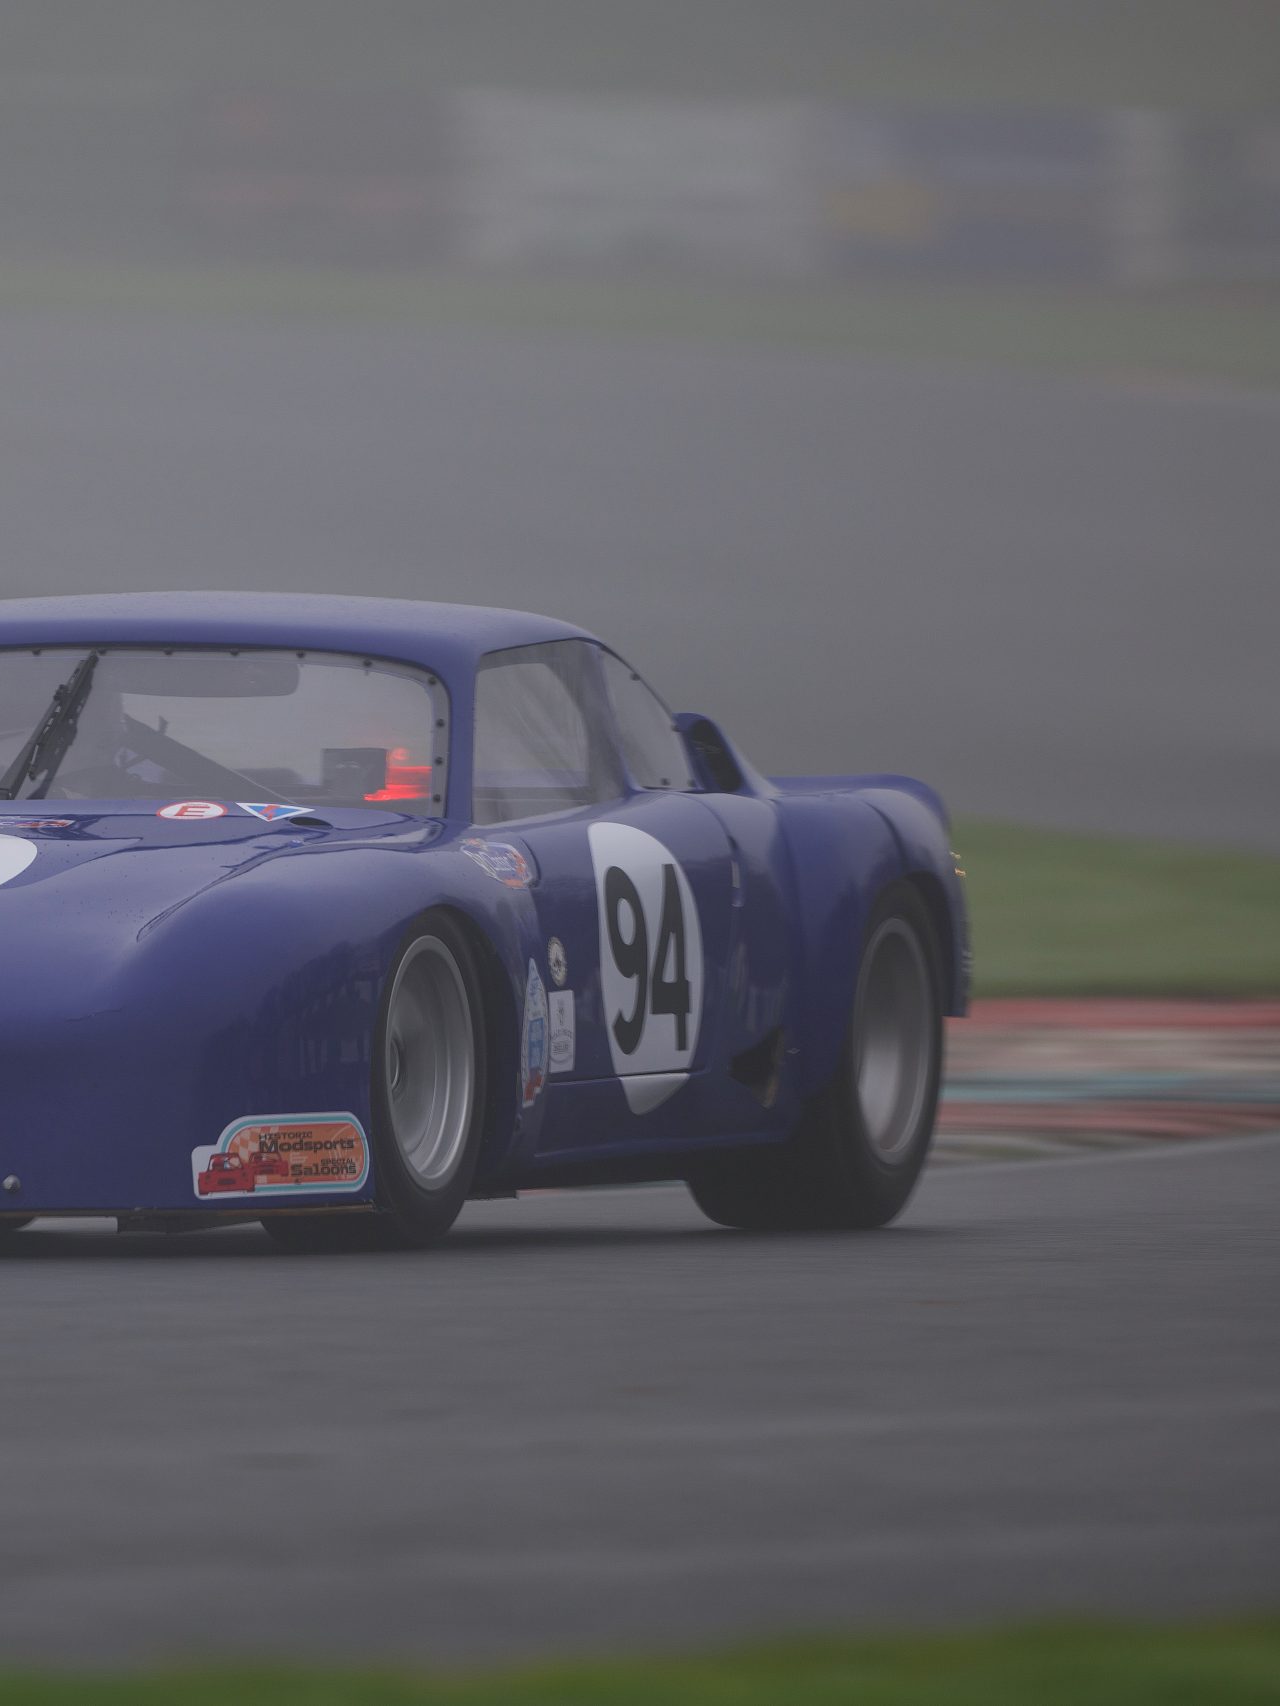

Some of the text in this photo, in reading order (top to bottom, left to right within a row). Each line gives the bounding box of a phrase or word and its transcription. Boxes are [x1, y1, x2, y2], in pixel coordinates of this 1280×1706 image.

[604, 863, 691, 1056] 94
[258, 1138, 355, 1153] Modsports
[290, 1164, 357, 1176] Saloons
